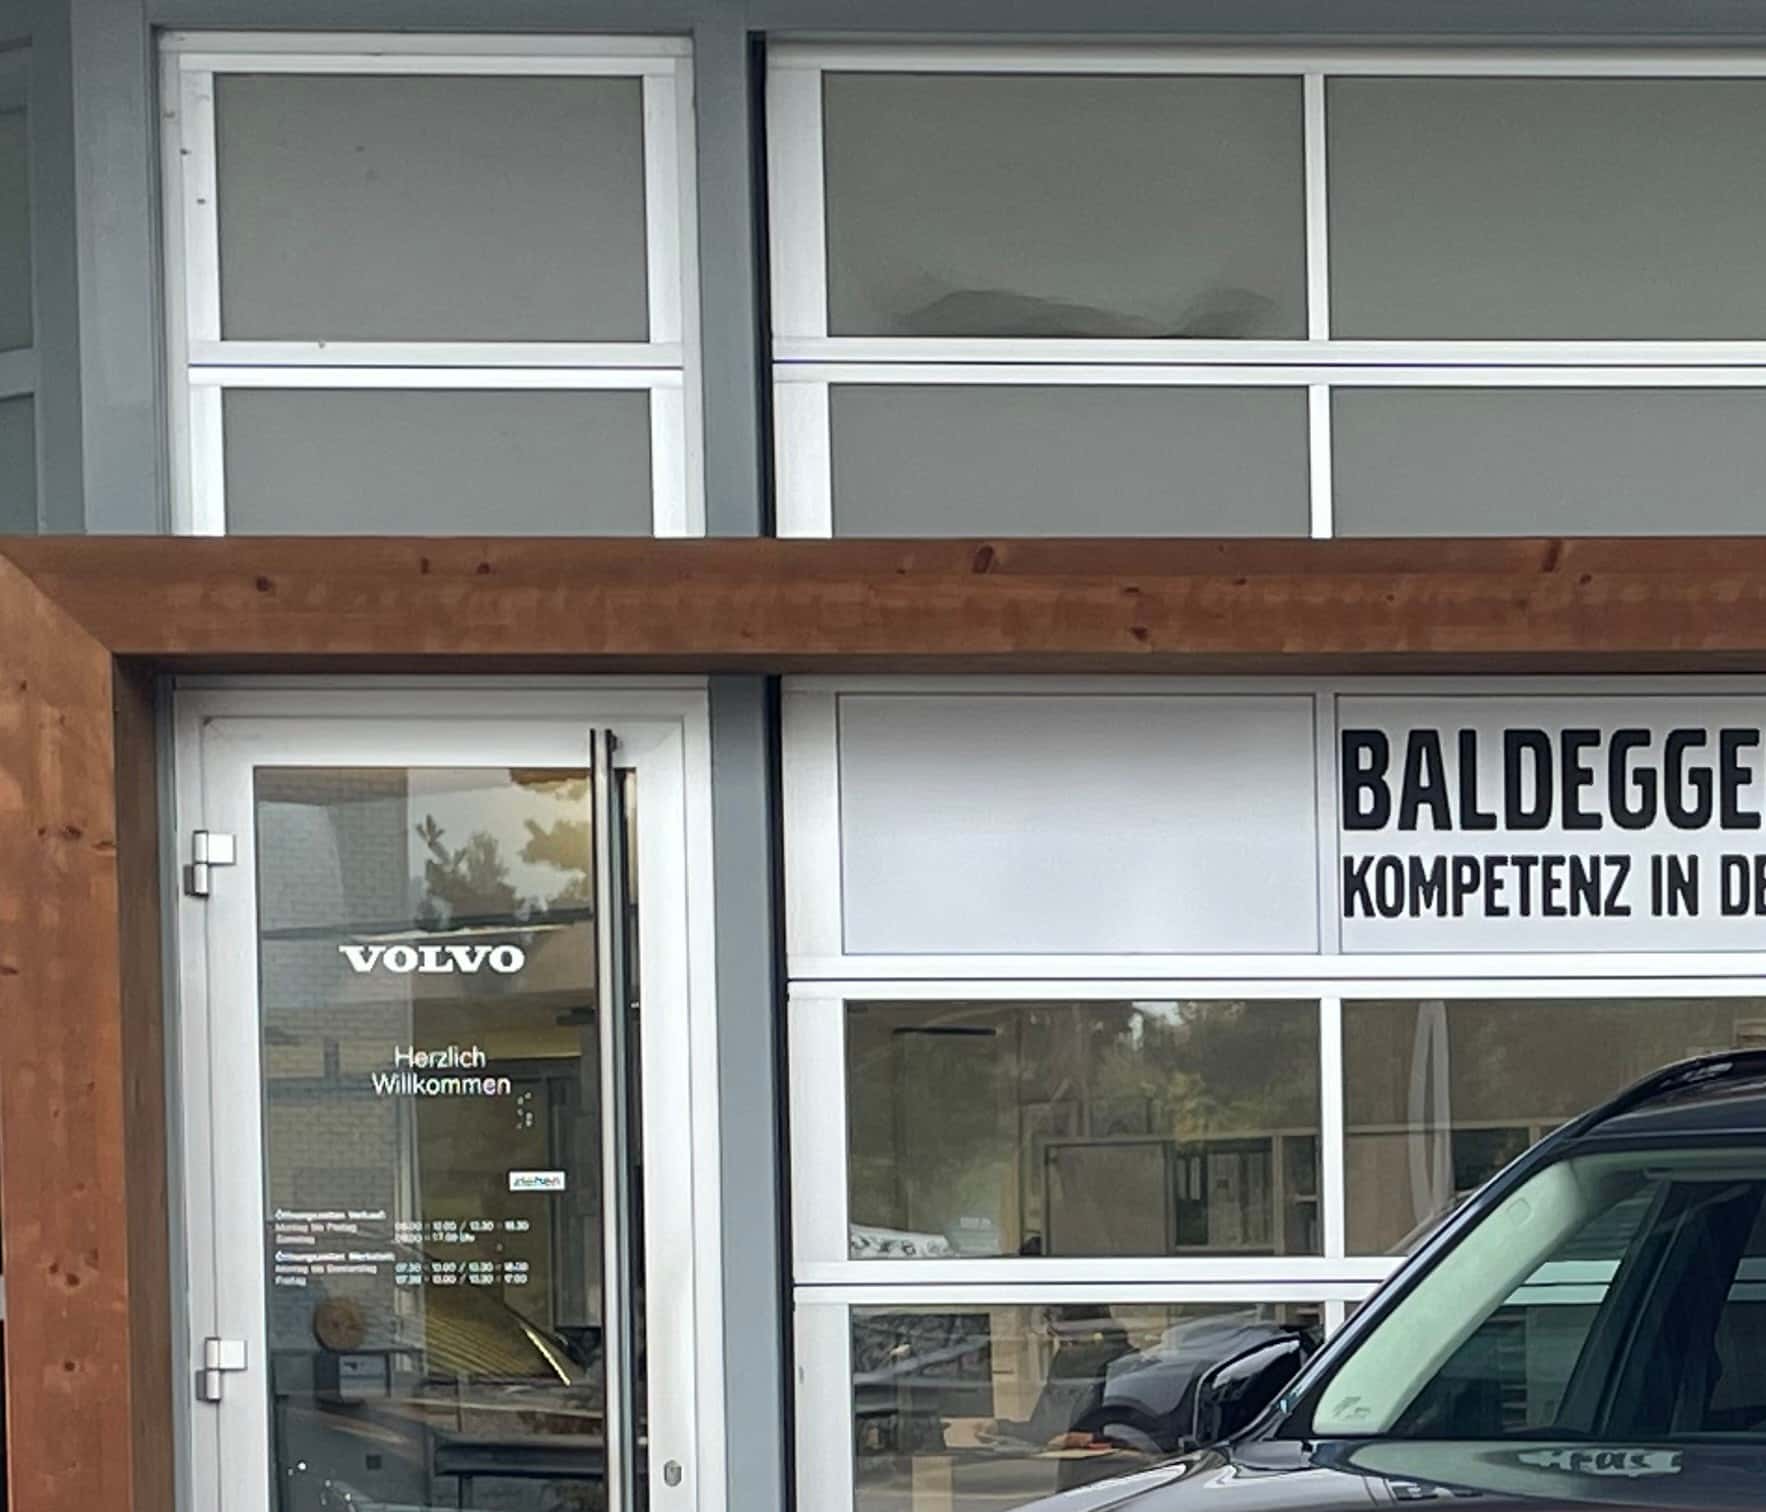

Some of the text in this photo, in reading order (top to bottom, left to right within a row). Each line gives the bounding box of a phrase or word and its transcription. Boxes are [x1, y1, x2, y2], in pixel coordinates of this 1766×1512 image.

[1342, 854, 1631, 918] KOMPETENZ
[1650, 853, 1699, 917] IN
[338, 944, 526, 974] VOLVO
[394, 1045, 487, 1069] Herzlich
[370, 1071, 512, 1096] Willkommen
